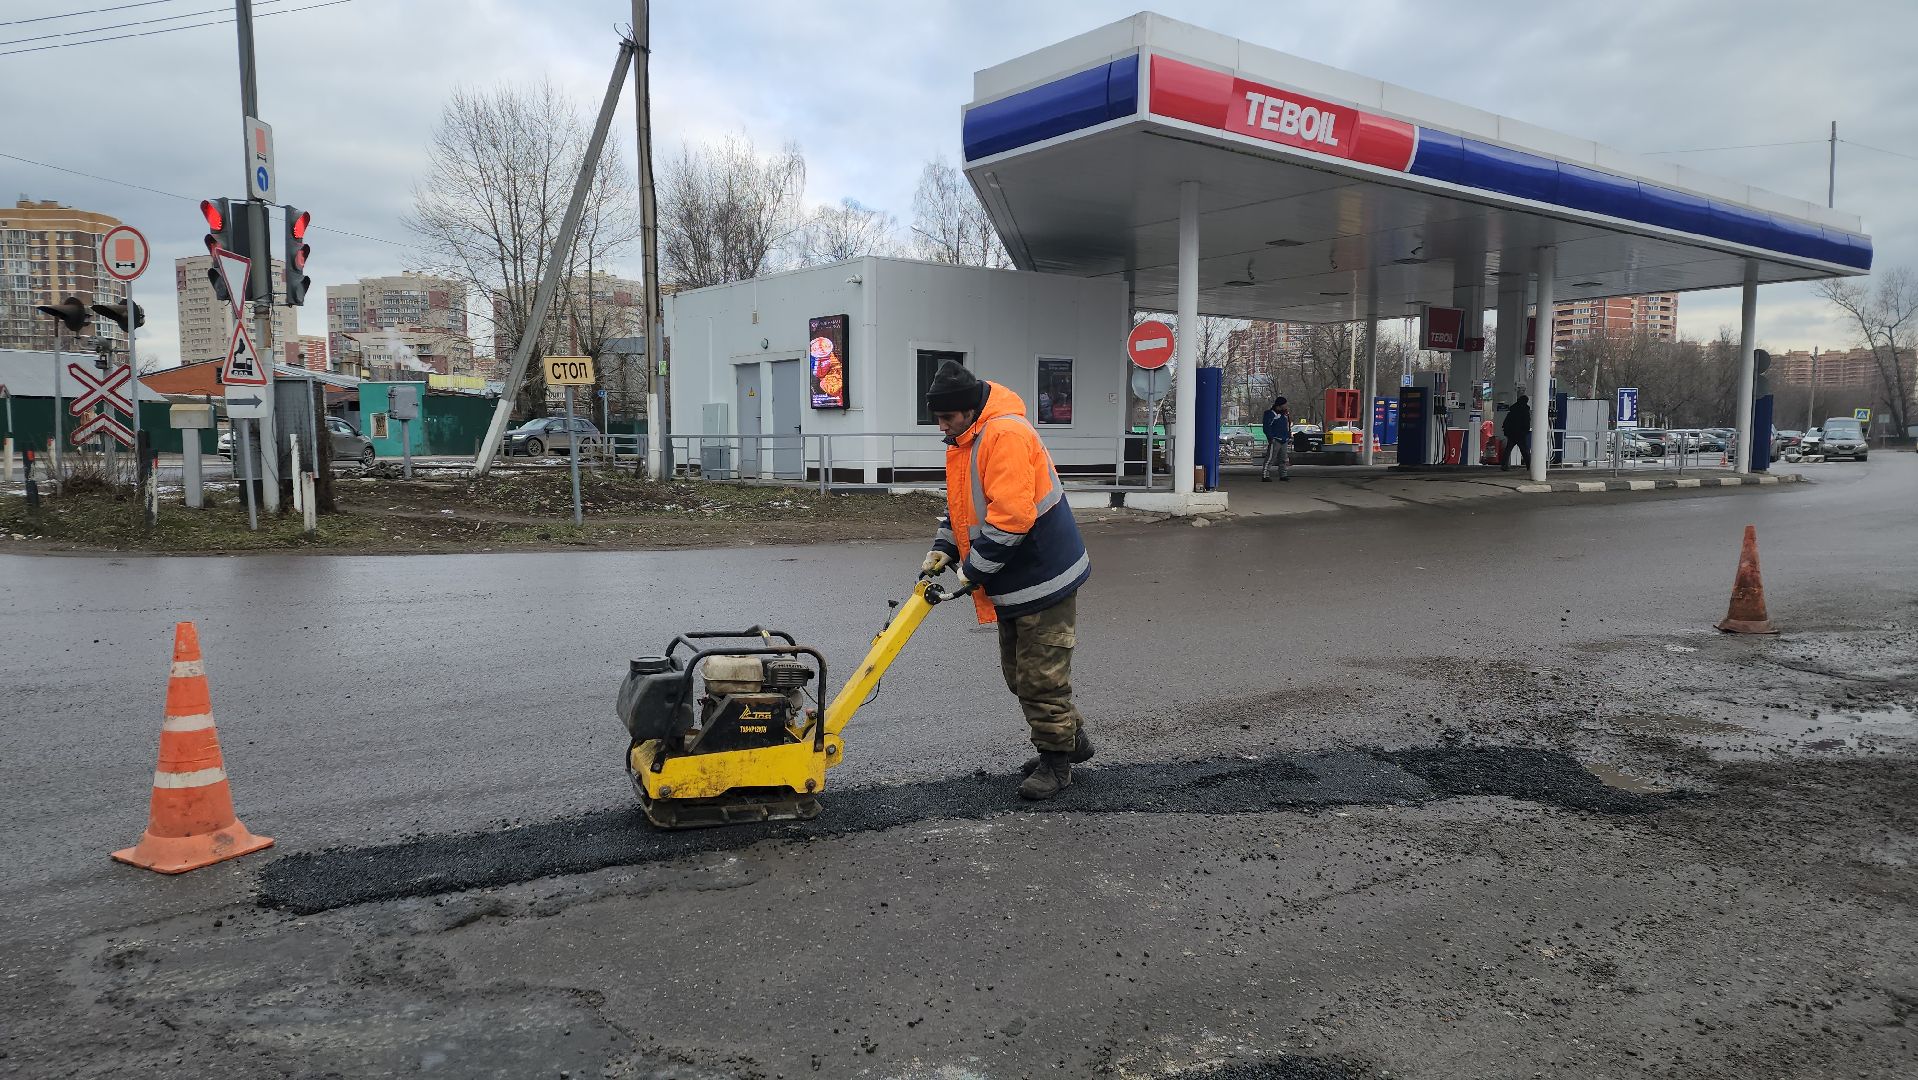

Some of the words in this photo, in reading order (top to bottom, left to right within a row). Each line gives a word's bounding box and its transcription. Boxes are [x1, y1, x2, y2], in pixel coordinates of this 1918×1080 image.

[1246, 91, 1339, 146] TEBOIL
[552, 362, 588, 379] СТОП
[1450, 447, 1456, 458] 3
